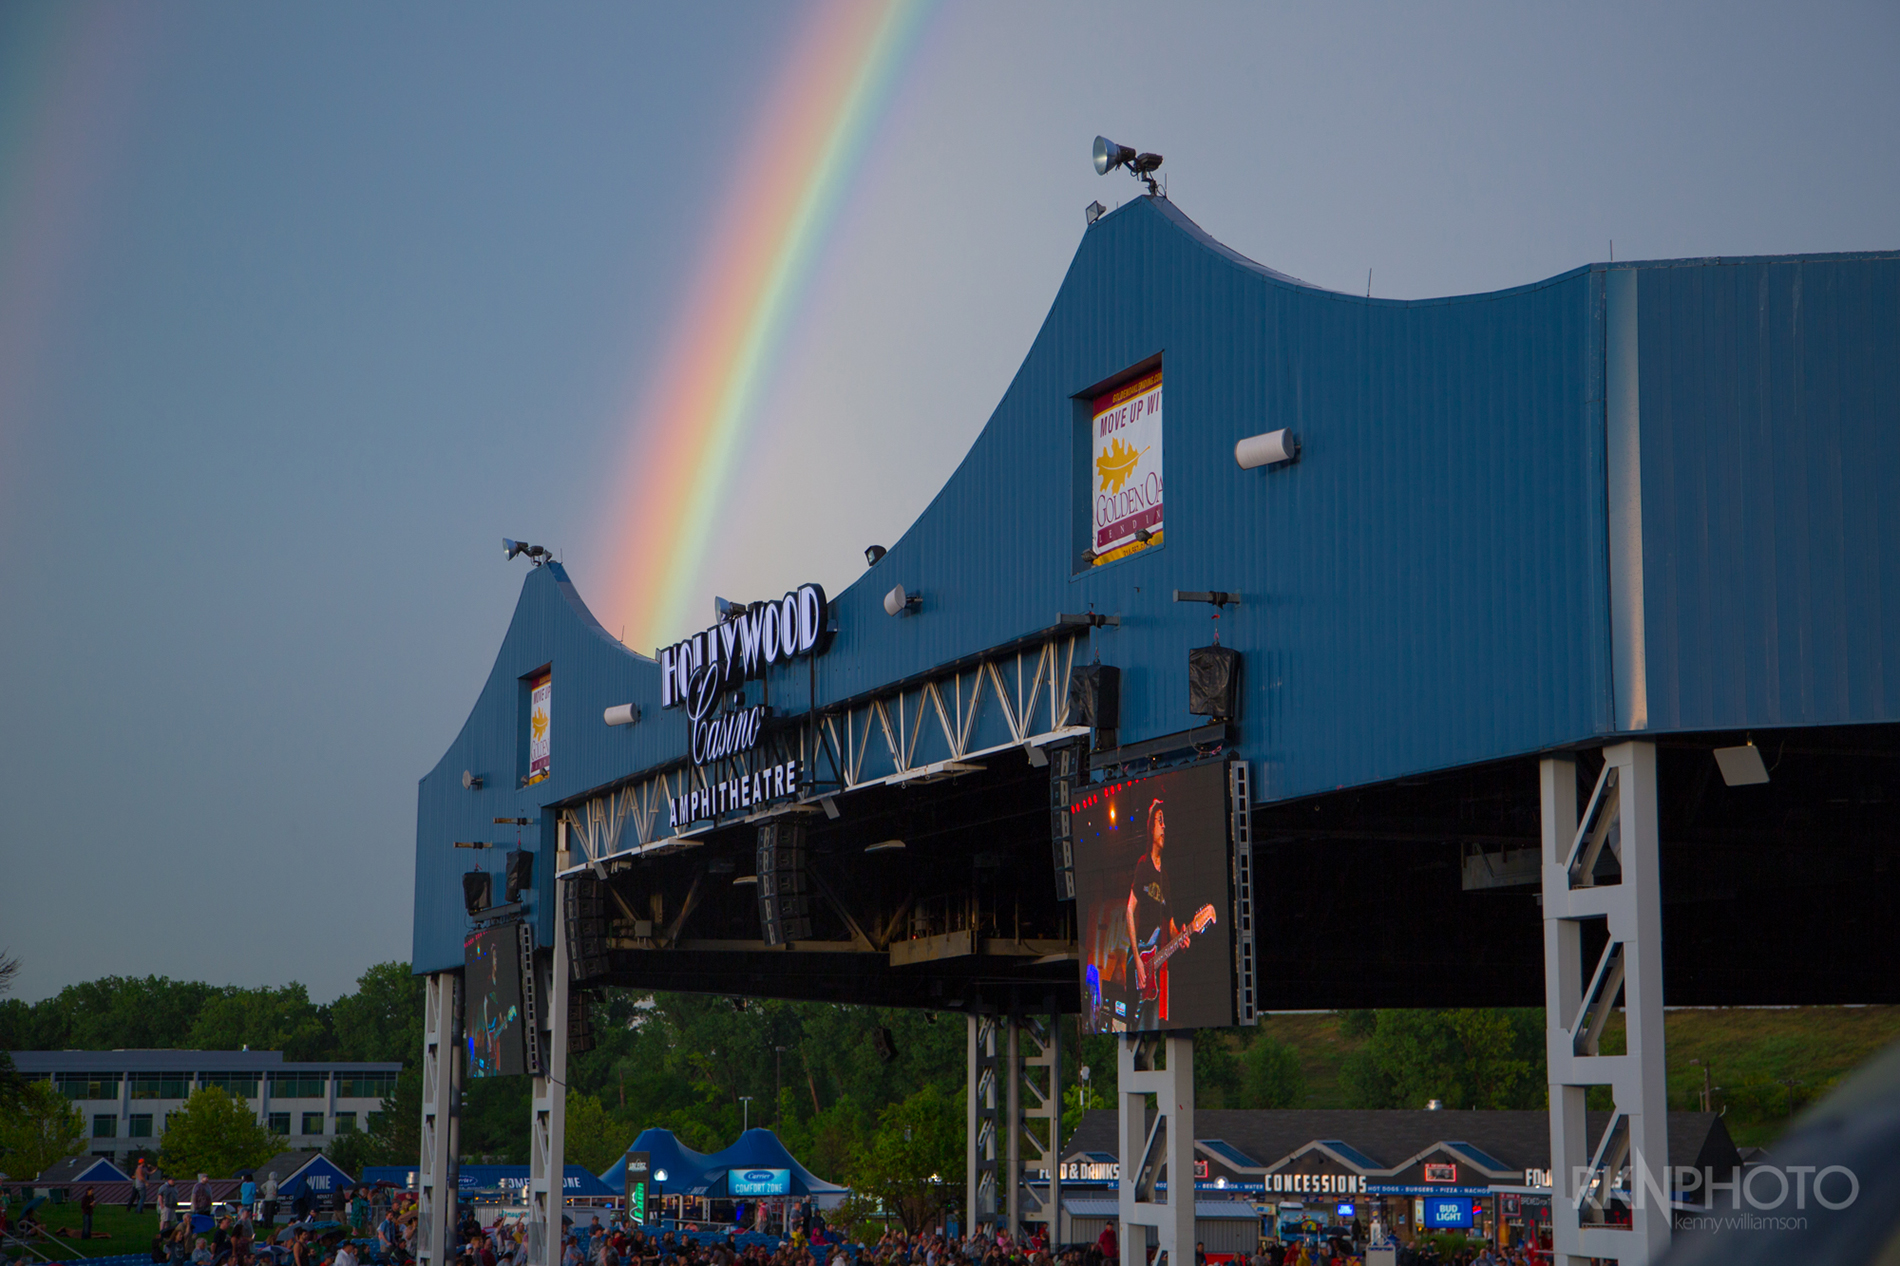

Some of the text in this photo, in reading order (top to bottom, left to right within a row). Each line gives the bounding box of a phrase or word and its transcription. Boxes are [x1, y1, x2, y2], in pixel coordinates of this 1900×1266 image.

[1100, 390, 1163, 438] MOVE UP WI
[1096, 483, 1144, 527] GOLDEN
[662, 586, 820, 708] HOLLYWOOD
[687, 663, 761, 765] Casino
[670, 761, 796, 828] AMPHITHEATRE
[747, 1172, 771, 1180] Carrier
[1069, 1163, 1080, 1180] &
[1080, 1163, 1120, 1180] DRINKS
[735, 1183, 783, 1193] COMFORT ZONE
[1264, 1174, 1367, 1193] CONCESSIONS
[1436, 1212, 1462, 1221] LIGHT
[1439, 1204, 1459, 1213] BUD
